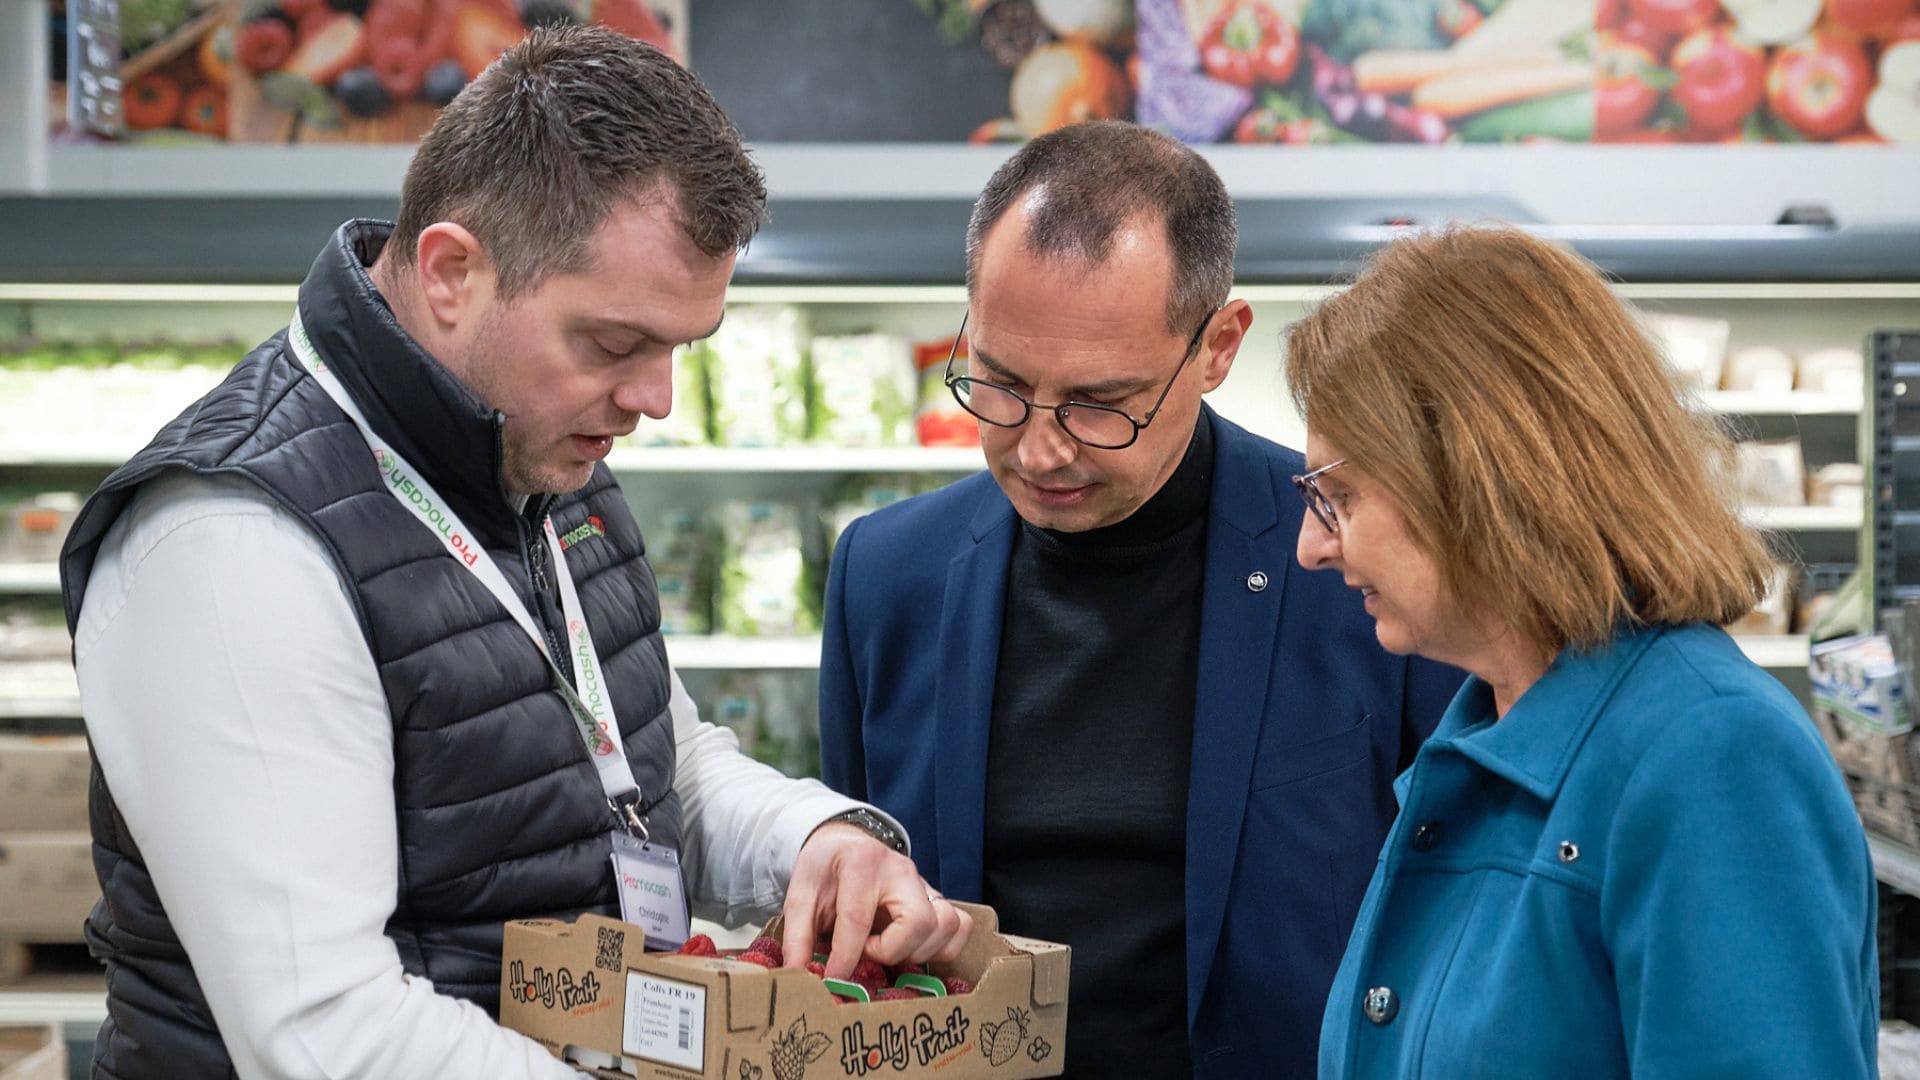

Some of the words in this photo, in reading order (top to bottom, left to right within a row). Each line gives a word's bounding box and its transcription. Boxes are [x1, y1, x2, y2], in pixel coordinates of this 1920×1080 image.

[391, 469, 478, 566] Promocash
[510, 960, 555, 1009] Holly
[556, 967, 600, 1011] fruit
[643, 982, 665, 995] Colis
[668, 987, 682, 999] FR
[685, 990, 696, 1001] 19
[841, 1019, 909, 1077] Holly
[910, 1006, 970, 1066] fruit
